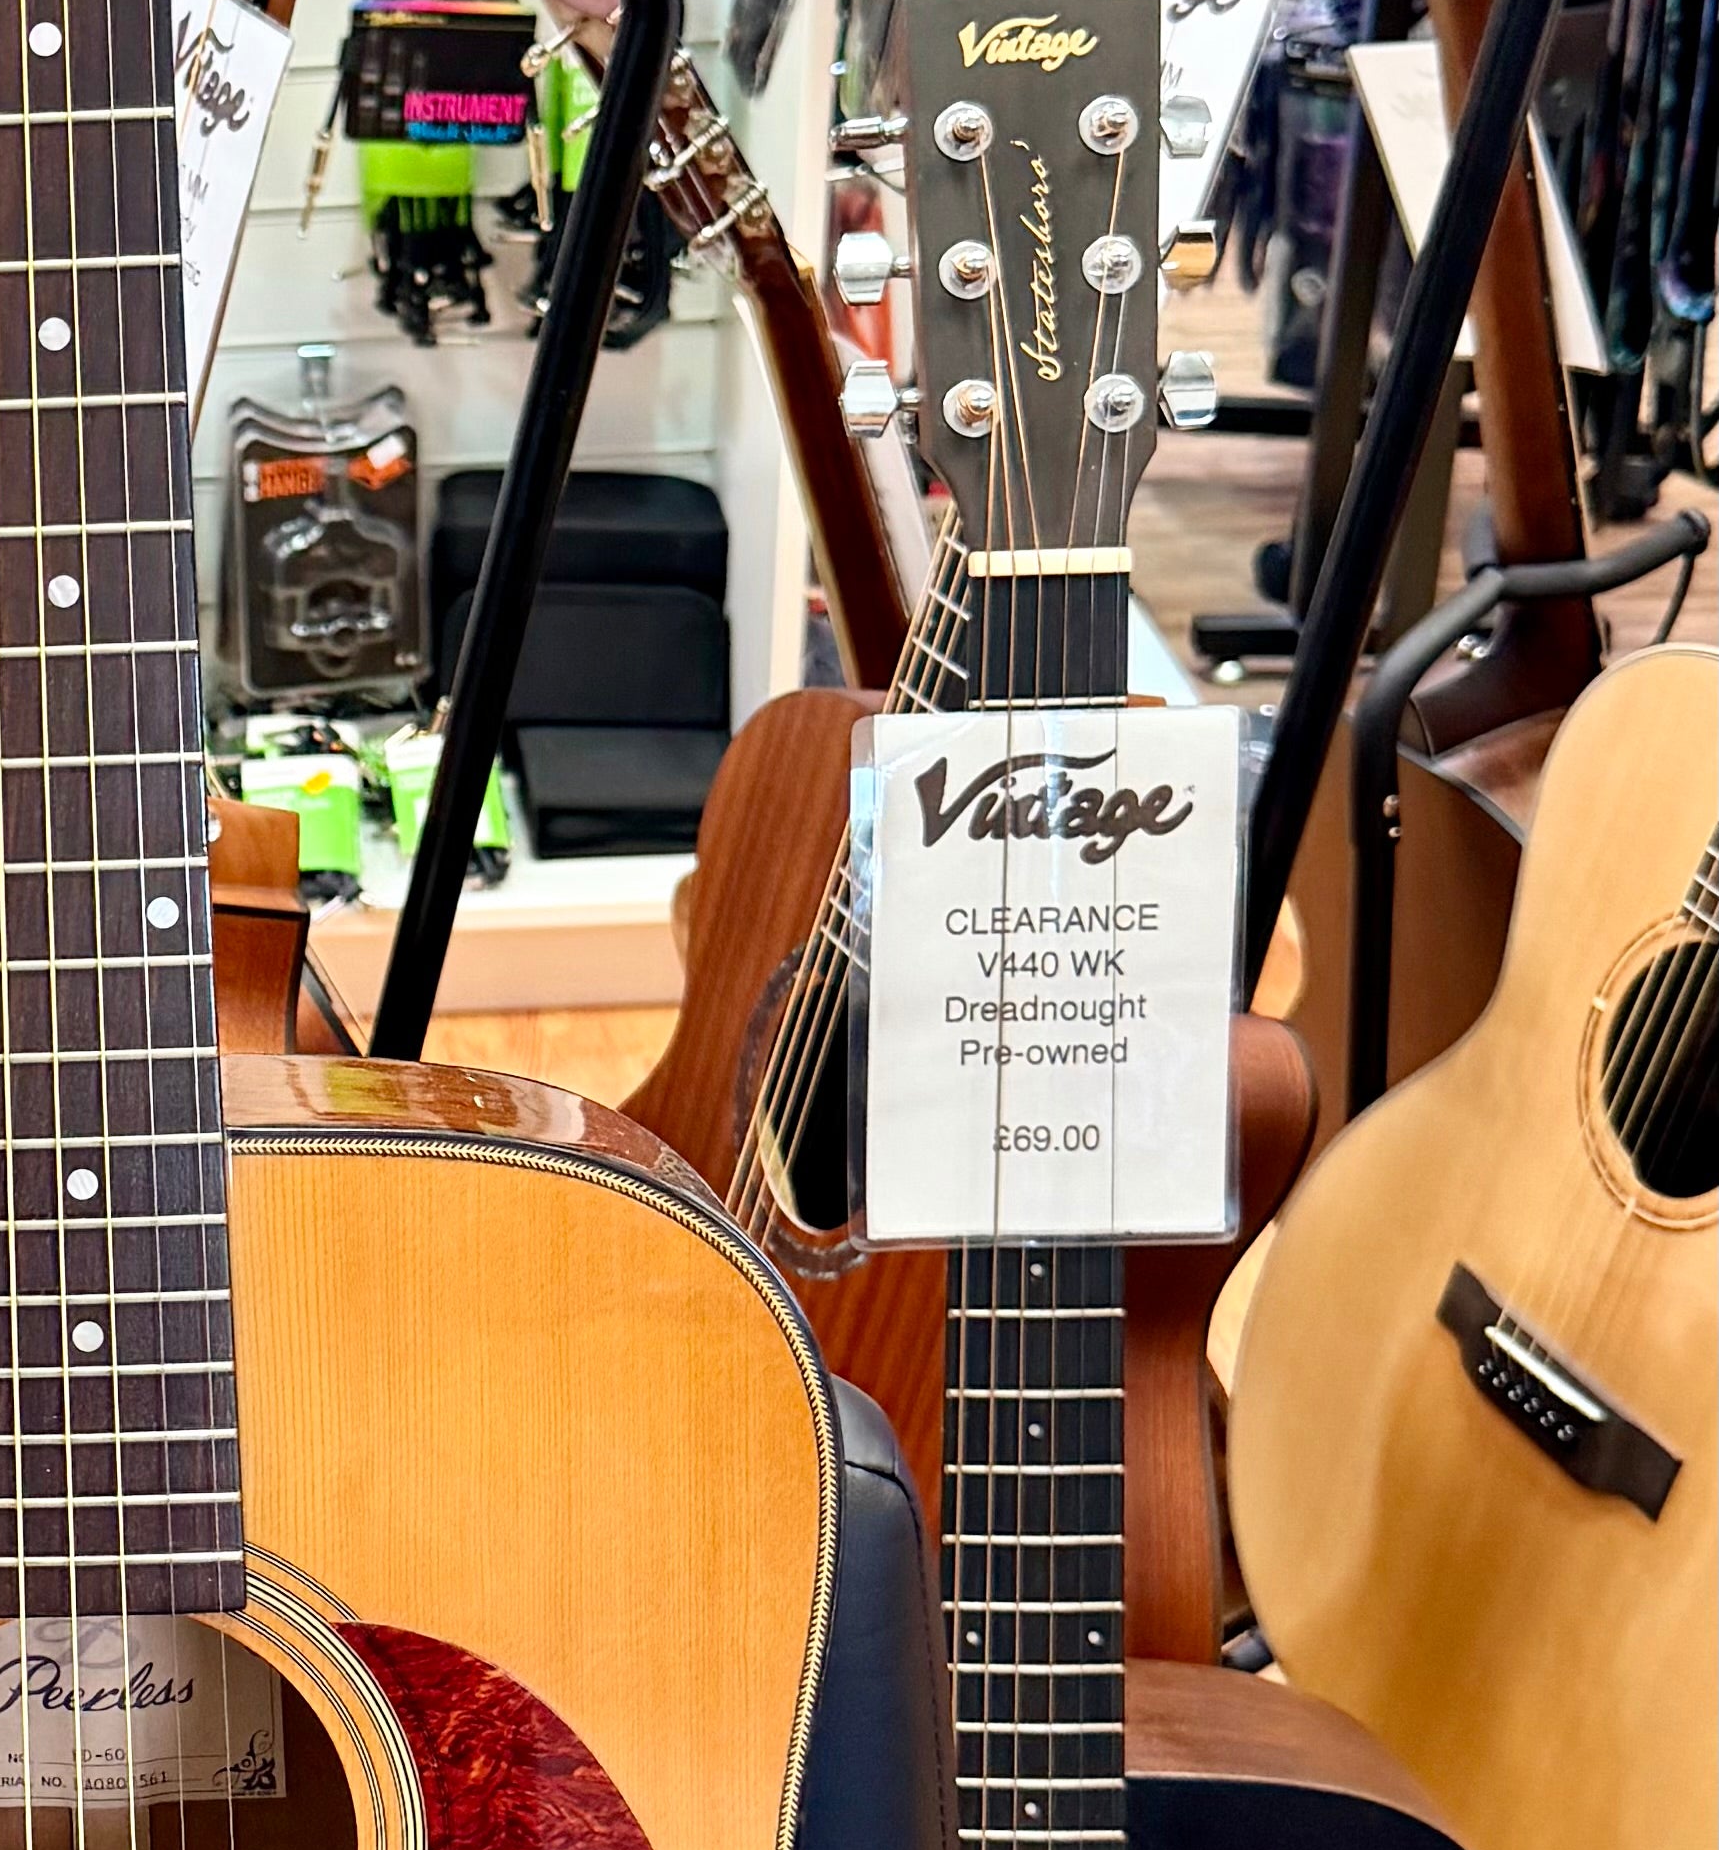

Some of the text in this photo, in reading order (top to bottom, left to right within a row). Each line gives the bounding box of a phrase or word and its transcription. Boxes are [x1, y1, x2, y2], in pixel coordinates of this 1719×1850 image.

[957, 12, 1099, 73] Vintage
[404, 91, 528, 125] INSTRUMENT
[913, 747, 1194, 865] Vintage
[945, 903, 1161, 937] CLEARANCE
[977, 949, 1126, 979] V440 WK
[944, 994, 1148, 1027] Dreadnought
[960, 1037, 1129, 1067] Pre-owned
[992, 1123, 1102, 1154] £69.00
[73, 1747, 126, 1763] D-60
[73, 1770, 169, 1792] A080561
